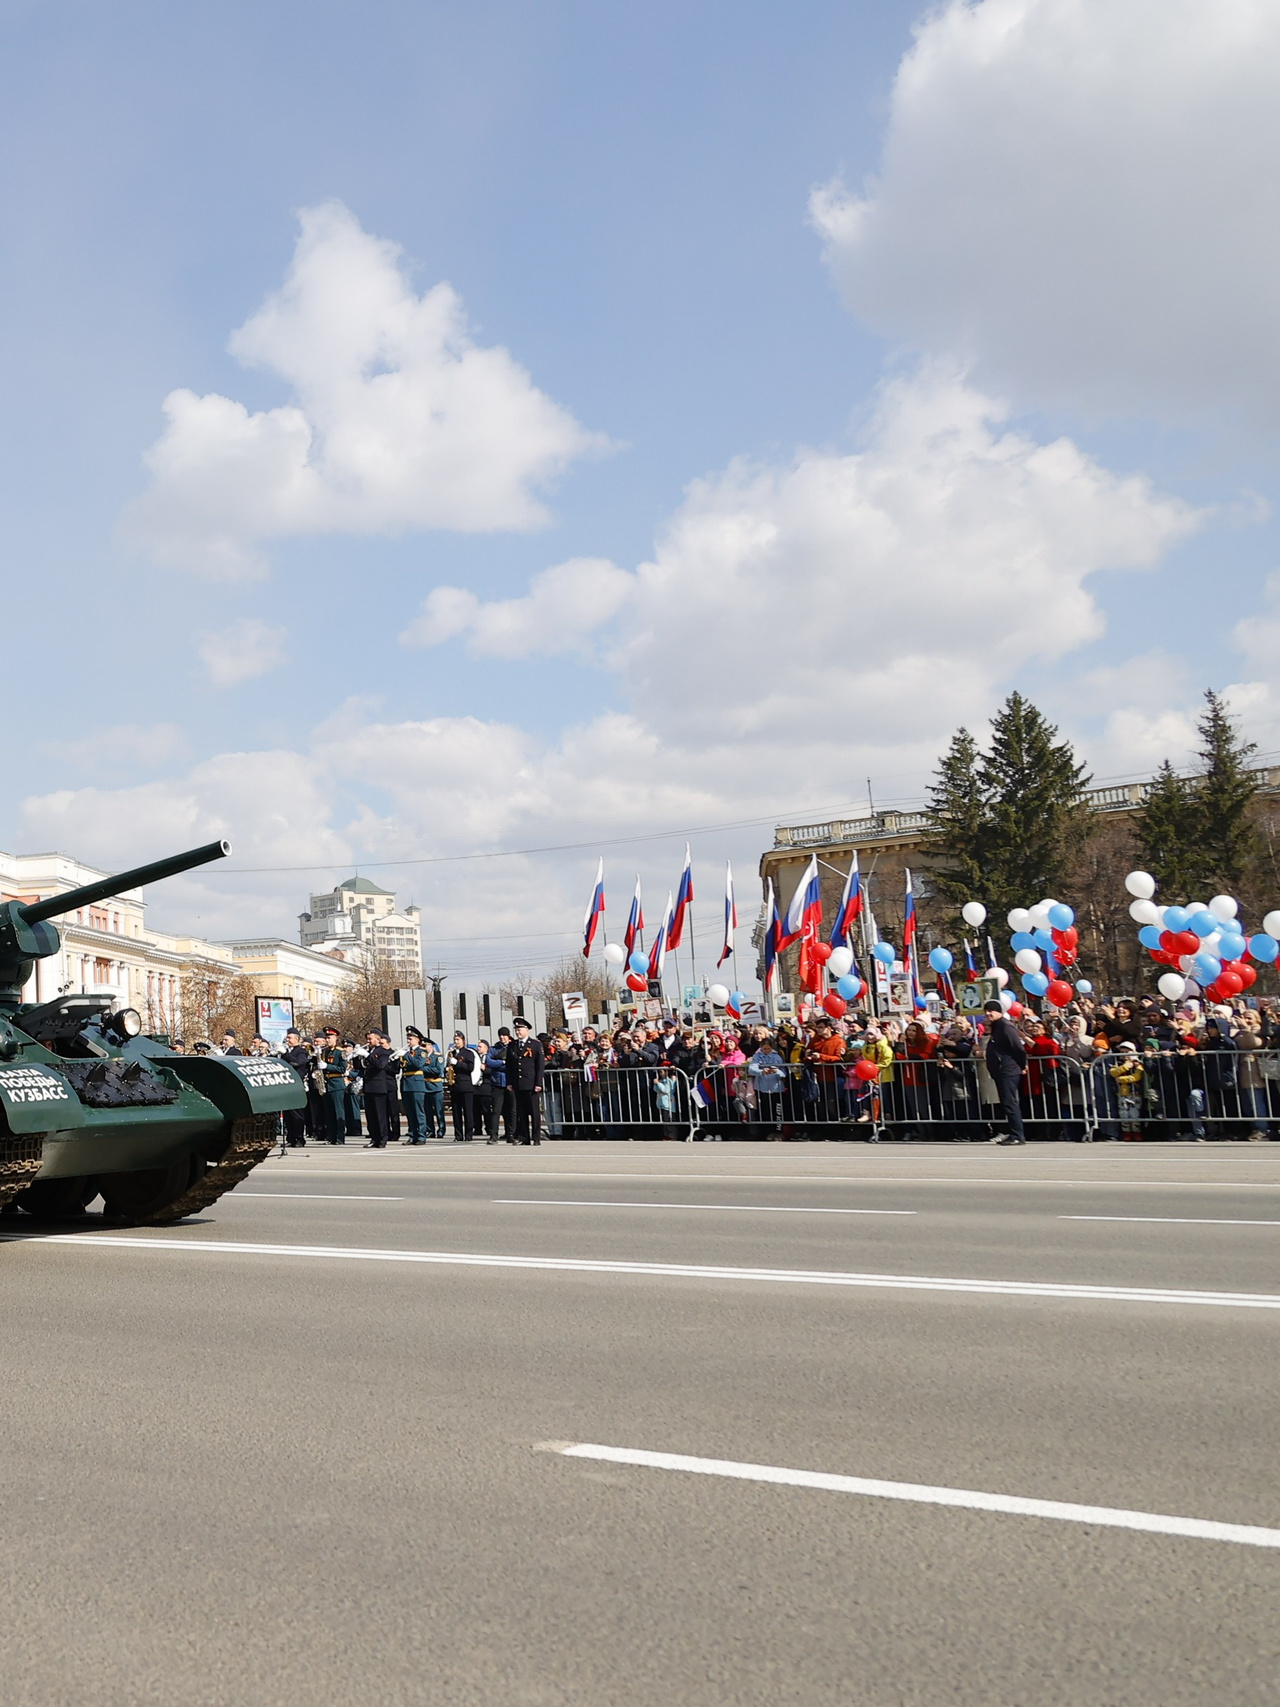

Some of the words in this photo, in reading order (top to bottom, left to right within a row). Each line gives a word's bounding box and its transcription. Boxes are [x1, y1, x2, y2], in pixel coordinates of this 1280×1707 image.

[565, 997, 582, 1009] Z
[740, 1002, 758, 1015] Z
[237, 1062, 290, 1076] ПОБЕДЫ.
[246, 1072, 295, 1087] КУЗБАСС
[7, 1087, 69, 1102] КУЗБАСС
